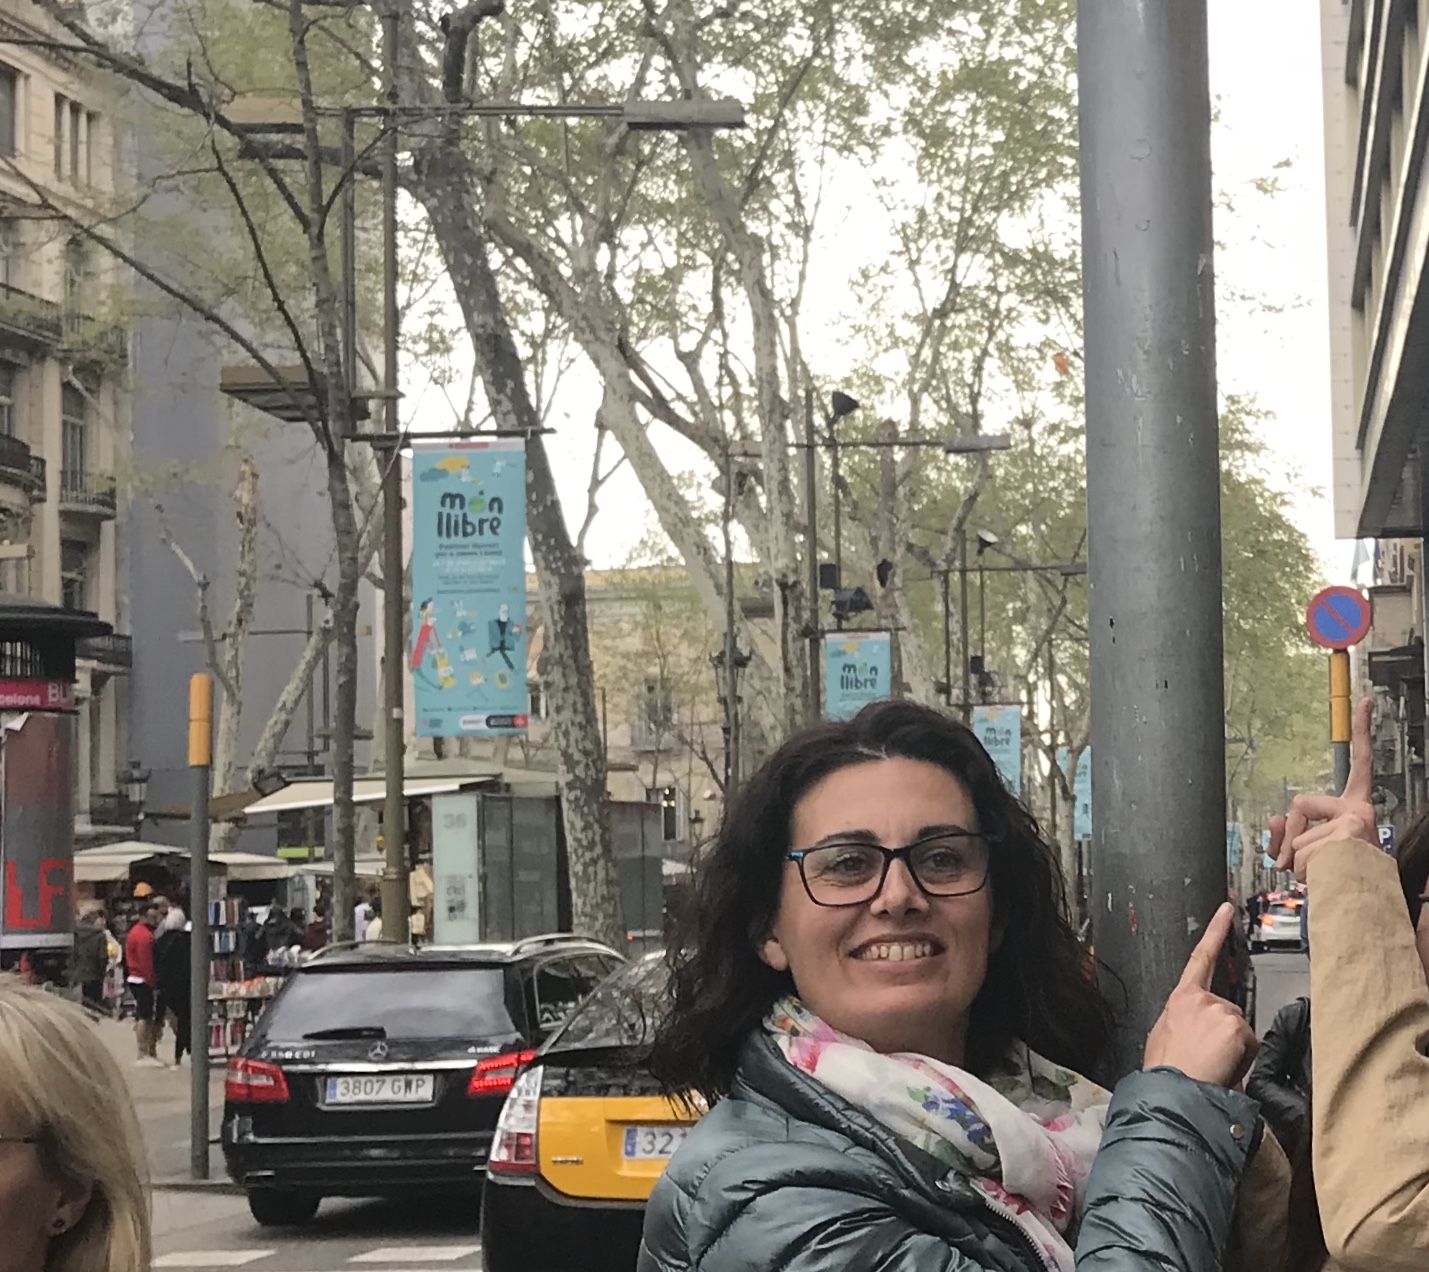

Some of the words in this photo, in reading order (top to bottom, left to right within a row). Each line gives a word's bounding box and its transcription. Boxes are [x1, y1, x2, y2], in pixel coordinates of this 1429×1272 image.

[437, 511, 502, 540] llibre
[840, 673, 877, 691] llibre
[340, 1080, 386, 1097] 3807
[642, 1128, 689, 1155] 32
